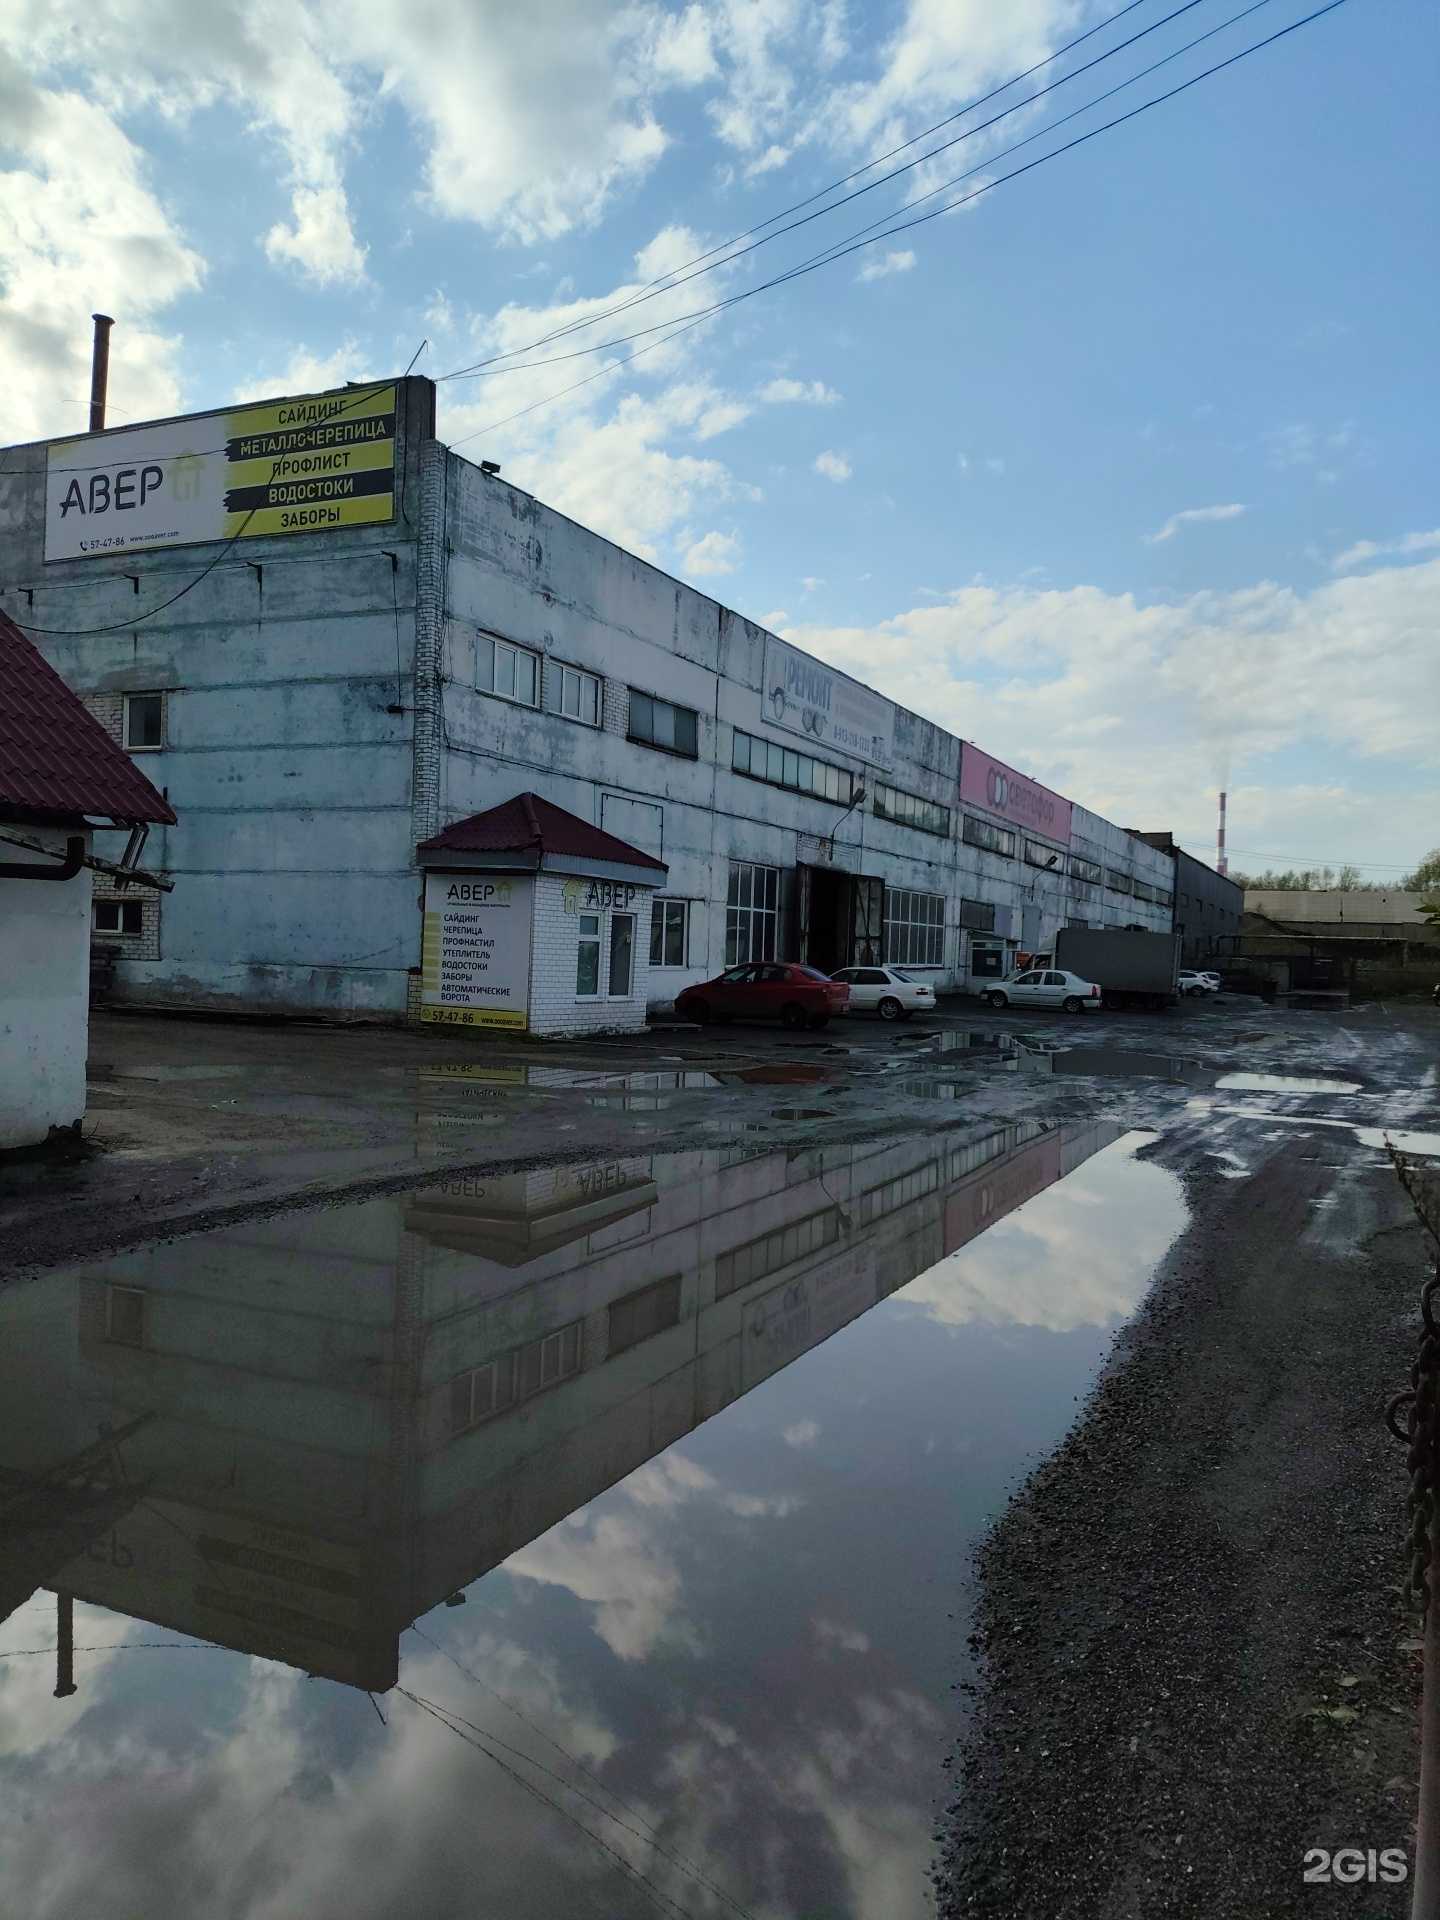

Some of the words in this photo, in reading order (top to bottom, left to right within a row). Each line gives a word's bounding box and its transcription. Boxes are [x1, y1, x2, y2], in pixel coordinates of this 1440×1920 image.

[278, 399, 347, 426] САЙДИНГ
[240, 419, 387, 456] МЕТАЛЛОЧЕРЕПИЦА
[273, 452, 350, 478] ПРОФЛИСТ
[60, 465, 164, 518] АВЕР
[268, 478, 353, 504] ВОДОСТОКИ
[280, 507, 341, 529] ЗАБОРЫ
[89, 536, 125, 550] 57-47-86
[447, 883, 495, 901] АВЕР
[586, 881, 636, 909] АВЕР
[443, 913, 480, 924] САЙДИНГ
[443, 925, 483, 936] ЧЕРЕПИЦА
[442, 937, 494, 948] ПРОФНАСТИЛ
[442, 949, 491, 960] УТЕПЛИТЕЛЬ
[441, 961, 488, 972] ВОДОСТОКИ
[441, 972, 473, 982] ЗАБОРЫ
[441, 984, 511, 997] АВТОМАТИЧЕСКИЕ
[440, 993, 471, 1003] ВОРОТА
[432, 1010, 474, 1024] 57-47-86
